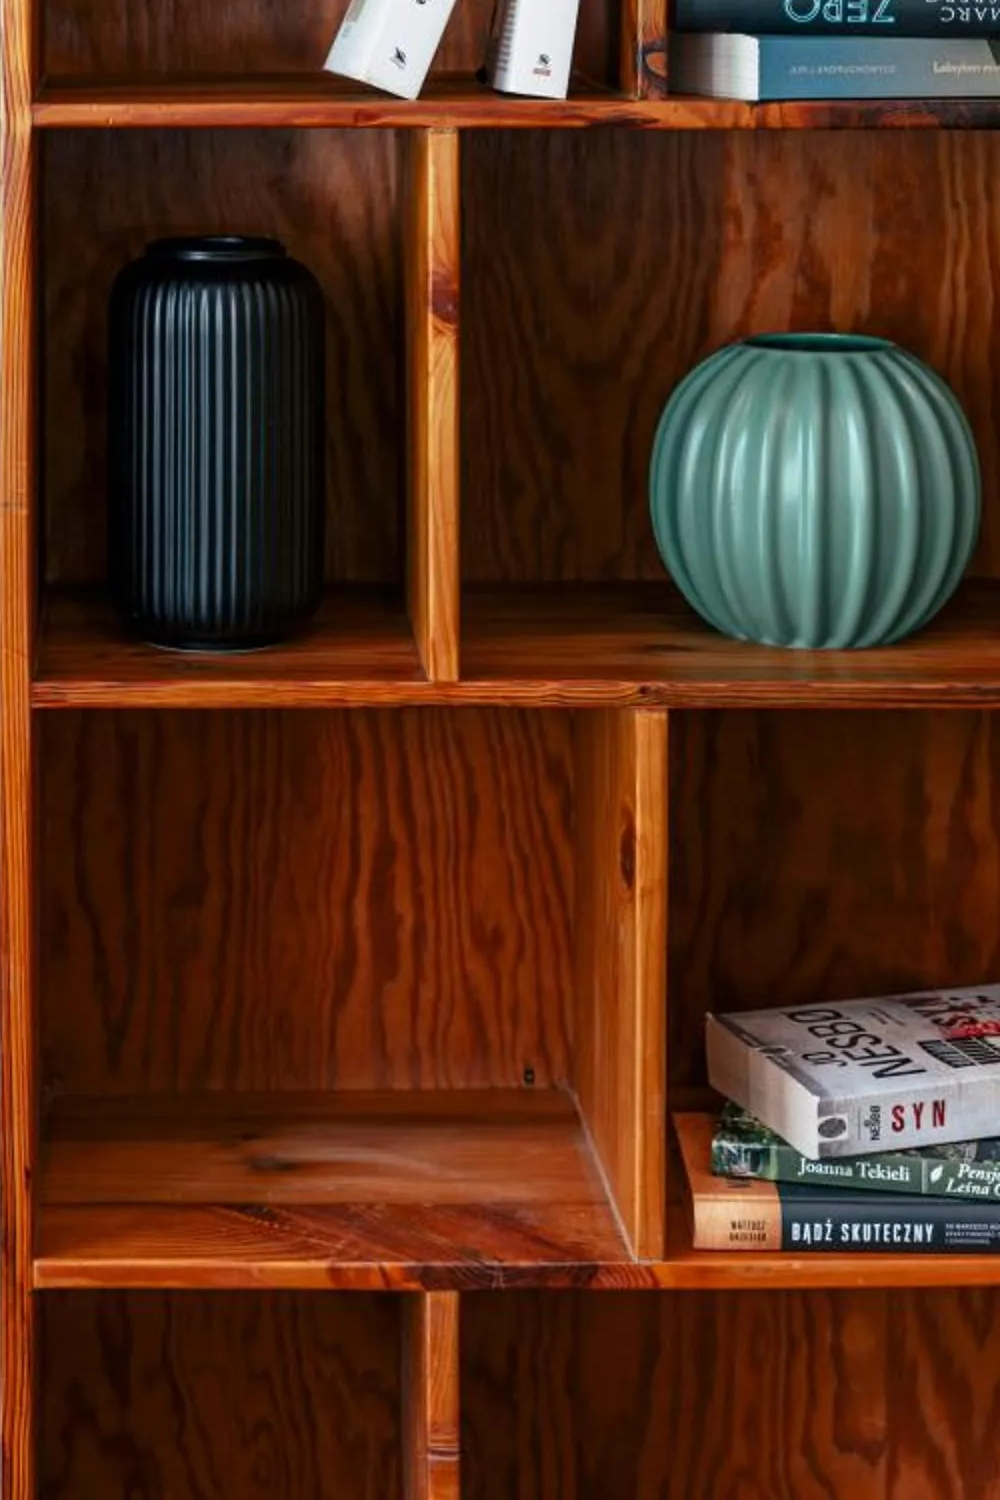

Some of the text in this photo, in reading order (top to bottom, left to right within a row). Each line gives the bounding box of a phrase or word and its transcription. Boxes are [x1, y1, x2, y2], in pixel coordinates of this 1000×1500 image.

[891, 1099, 946, 1133] SYN
[798, 1157, 911, 1183] Joanna Tekieli
[958, 1162, 1000, 1185] Pensj
[791, 1218, 934, 1244] BĄDŹ SKUTECZNY
